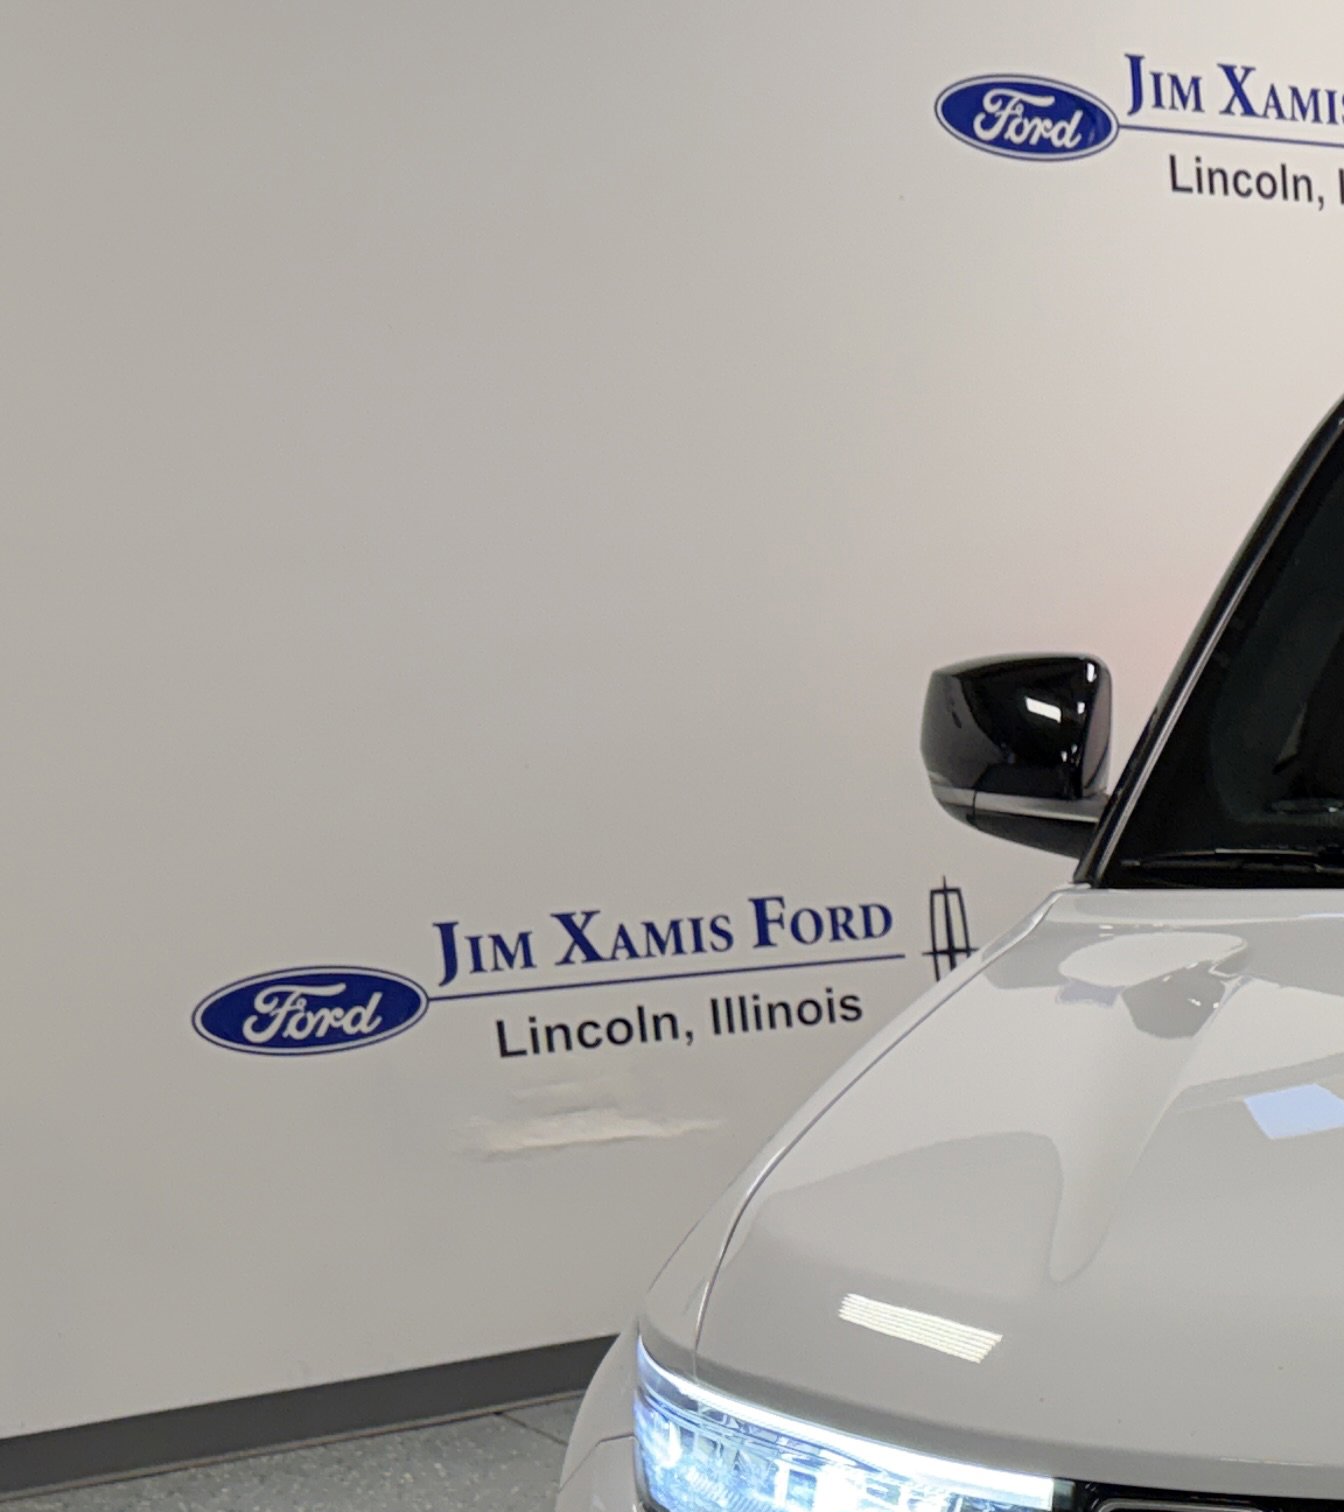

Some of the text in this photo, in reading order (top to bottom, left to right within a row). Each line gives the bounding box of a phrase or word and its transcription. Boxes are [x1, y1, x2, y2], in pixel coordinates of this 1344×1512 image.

[1125, 53, 1205, 116] JIM
[973, 88, 1082, 150] Ford
[1169, 155, 1325, 211] Lincoln,
[432, 896, 893, 987] JIM XAMIS FORD
[242, 983, 381, 1044] Ford
[495, 987, 863, 1058] Lincoln, Illinois
